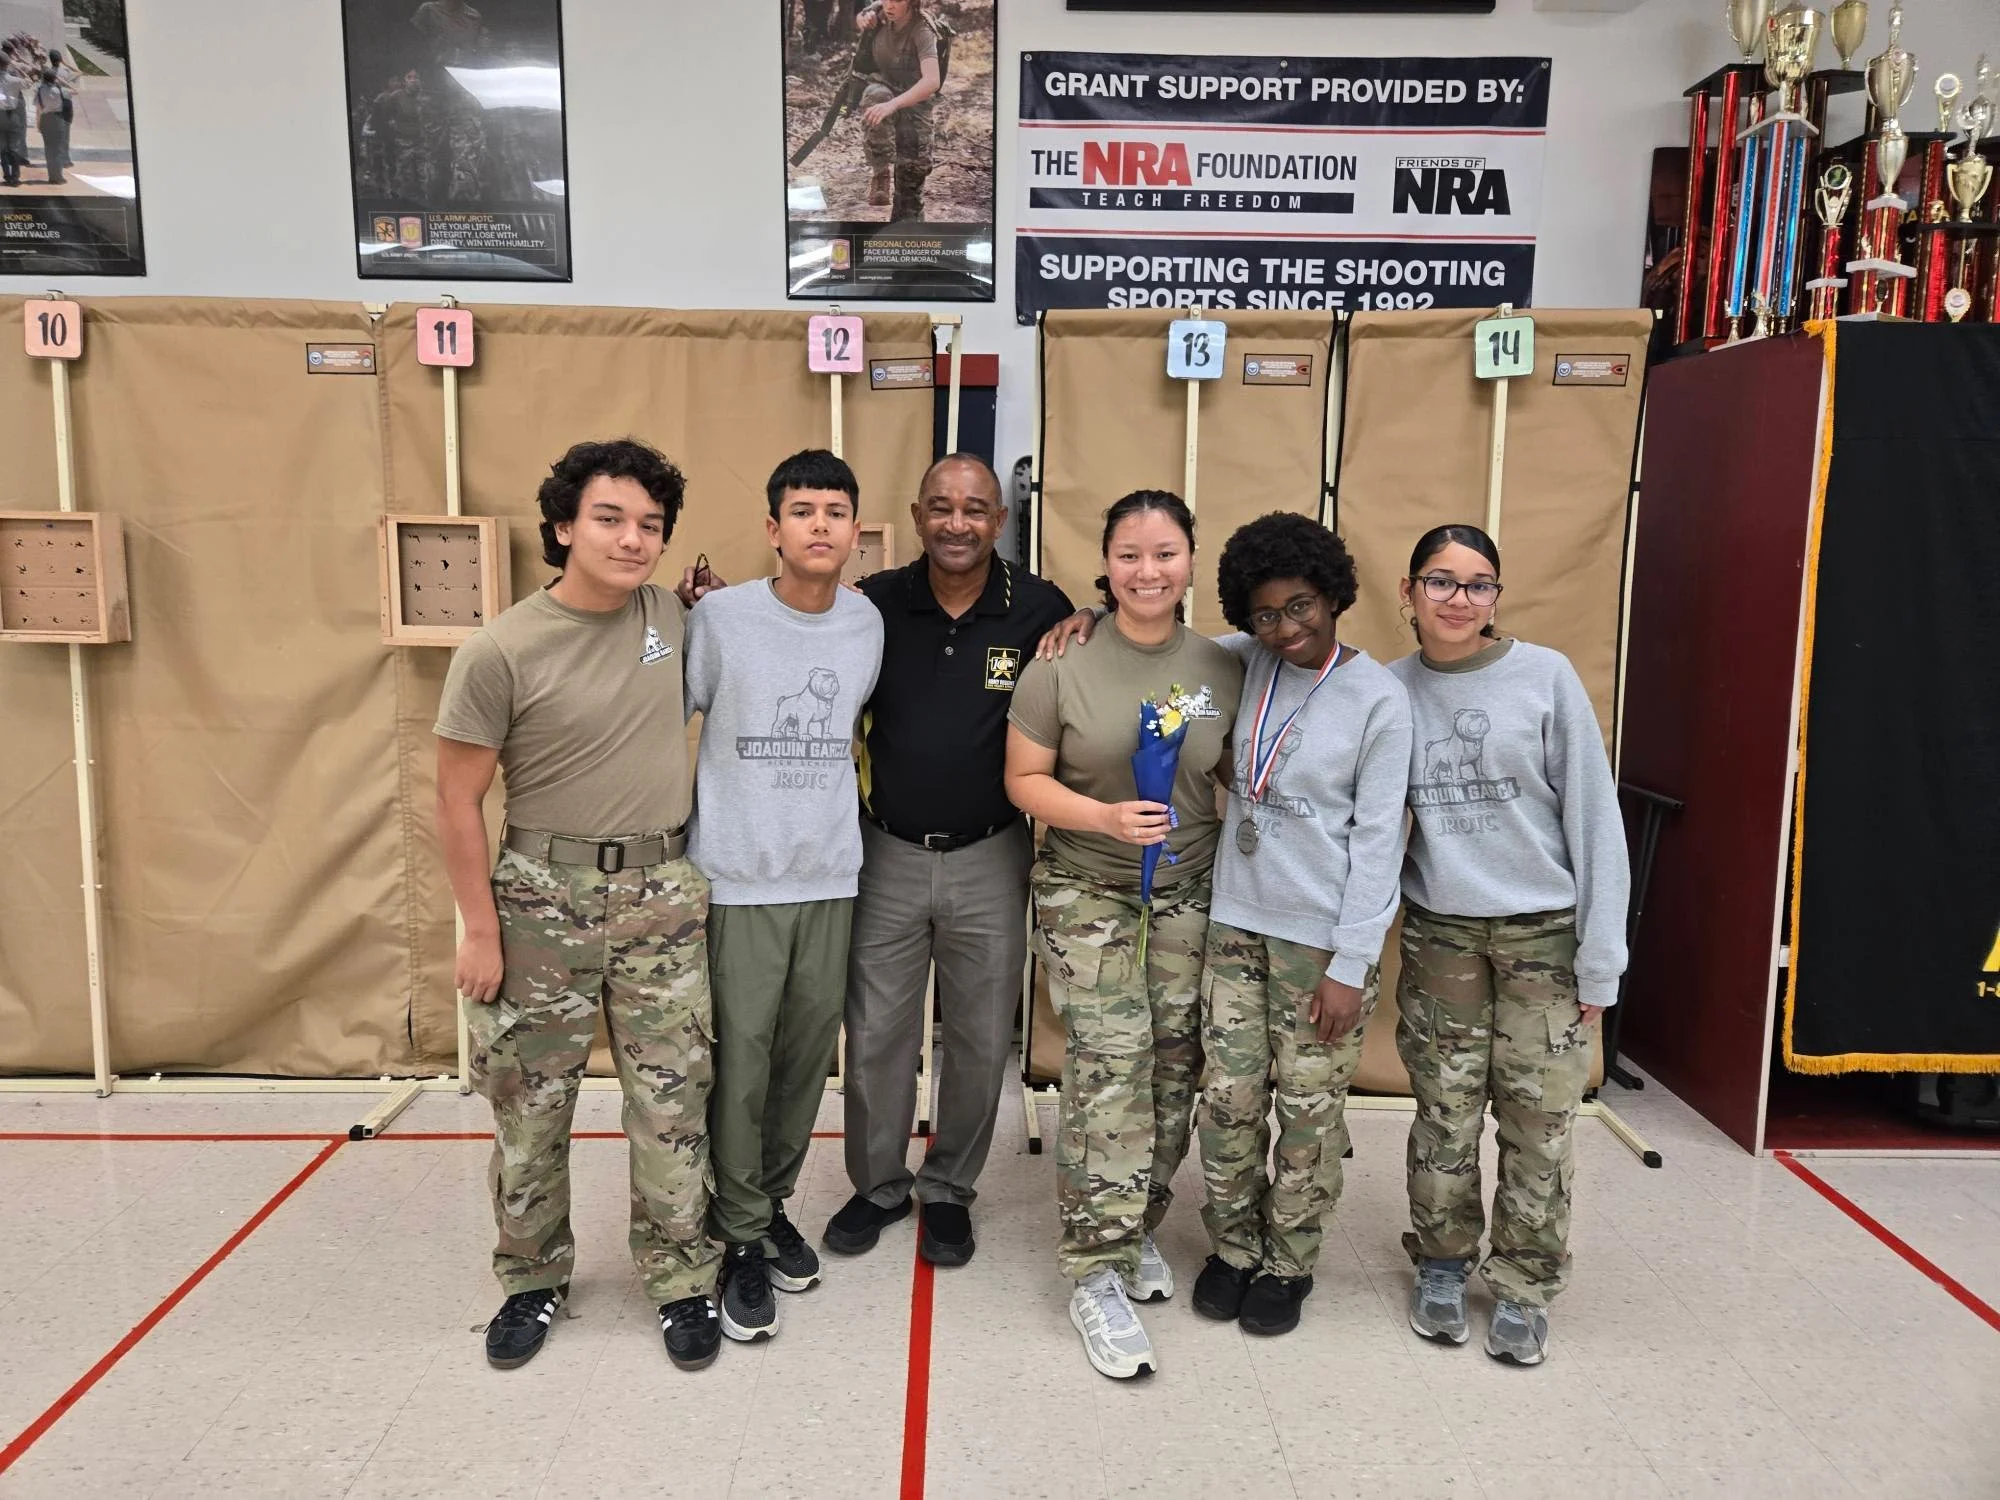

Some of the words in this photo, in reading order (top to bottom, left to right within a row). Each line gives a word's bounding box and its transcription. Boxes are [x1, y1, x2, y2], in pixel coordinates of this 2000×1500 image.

[1045, 71, 1149, 98] GRANT
[1158, 75, 1301, 101] SUPPORT
[1311, 77, 1467, 104] PROVIDED
[1477, 79, 1524, 104] BY:
[1031, 150, 1078, 176] THE
[1082, 141, 1192, 186] NRA
[1196, 152, 1357, 180] FOUNDATION
[1398, 158, 1459, 168] FRIENDS
[1465, 159, 1483, 169] OF
[1082, 192, 1162, 207] TEACH
[1184, 193, 1300, 209] FREEDOM
[1393, 168, 1511, 215] NRA
[3, 213, 33, 221] HONOR
[4, 222, 24, 230] LIVE
[24, 222, 35, 230] UP
[36, 222, 48, 230] TO
[467, 215, 493, 223] JROTC
[6, 230, 28, 238] ARMY
[449, 223, 470, 231] YOUR
[471, 223, 488, 231] LIFE
[475, 231, 495, 239] LOSE
[497, 231, 518, 239] WITH
[467, 239, 484, 247] WIN
[484, 239, 506, 248] WITH
[863, 248, 881, 256] FACE
[863, 255, 899, 263] (PHYSICAL
[911, 256, 938, 264] MORAL)
[1039, 254, 1249, 284] SUPPORTING
[1260, 258, 1325, 284] THE
[1335, 258, 1506, 286] SHOOTING
[1107, 287, 1236, 310] SPORTS
[1247, 289, 1345, 311] SINCE
[1357, 291, 1434, 311] 1992
[37, 312, 67, 346] 10
[434, 321, 456, 355] 11
[822, 327, 850, 361] 12
[1182, 332, 1211, 367] 13
[1488, 330, 1520, 366] 14
[743, 740, 806, 757] JOAQUIN
[771, 769, 828, 789] JROTC
[1436, 811, 1500, 835] JROTC
